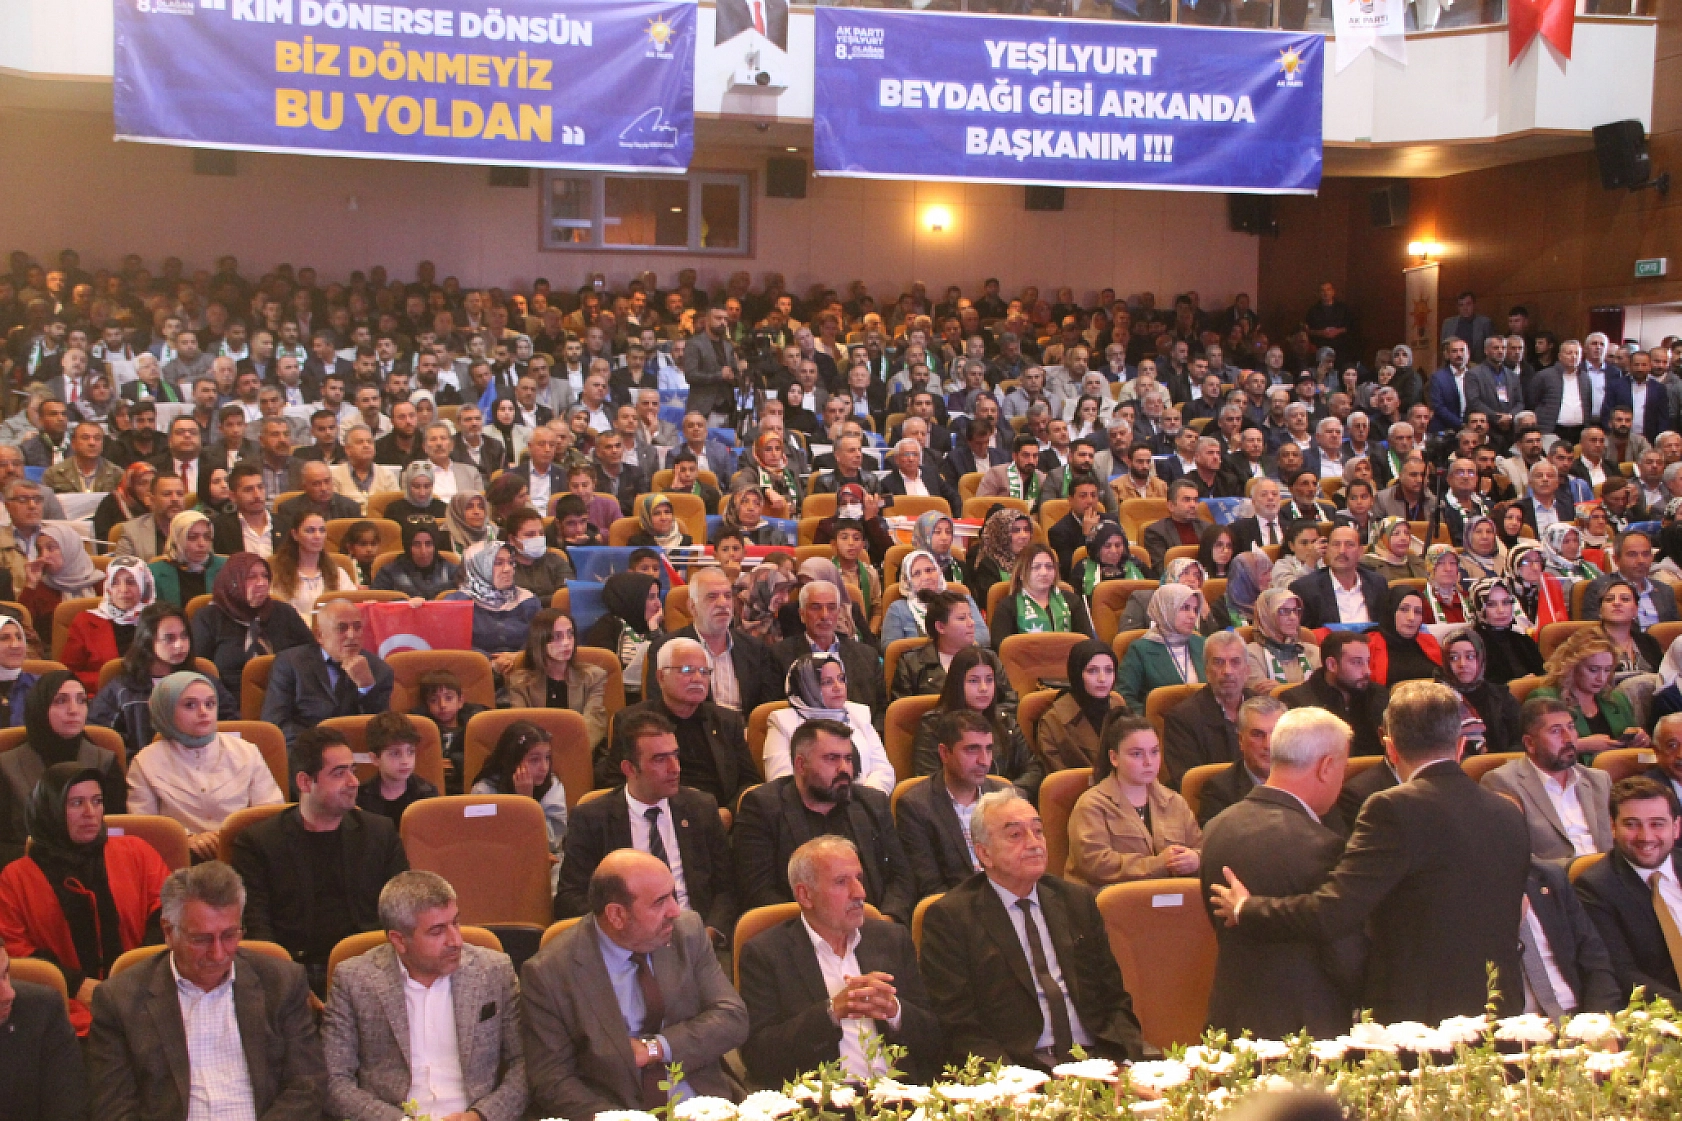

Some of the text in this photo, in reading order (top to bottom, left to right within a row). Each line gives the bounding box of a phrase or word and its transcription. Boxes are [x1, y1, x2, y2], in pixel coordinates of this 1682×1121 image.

[300, 0, 454, 36] DÖNERSE
[459, 7, 593, 46] DÖNSÜN
[836, 26, 852, 37] AK
[275, 35, 553, 90] BİZ DÖNMEYİZ
[983, 37, 1158, 76] YEŞİLYURT
[276, 88, 344, 131] BU
[355, 93, 554, 143] YOLDAN
[880, 78, 1256, 124] BEYDAĞI GİBİ ARKANDA
[965, 126, 1174, 163] BAŞKANIM !!!
